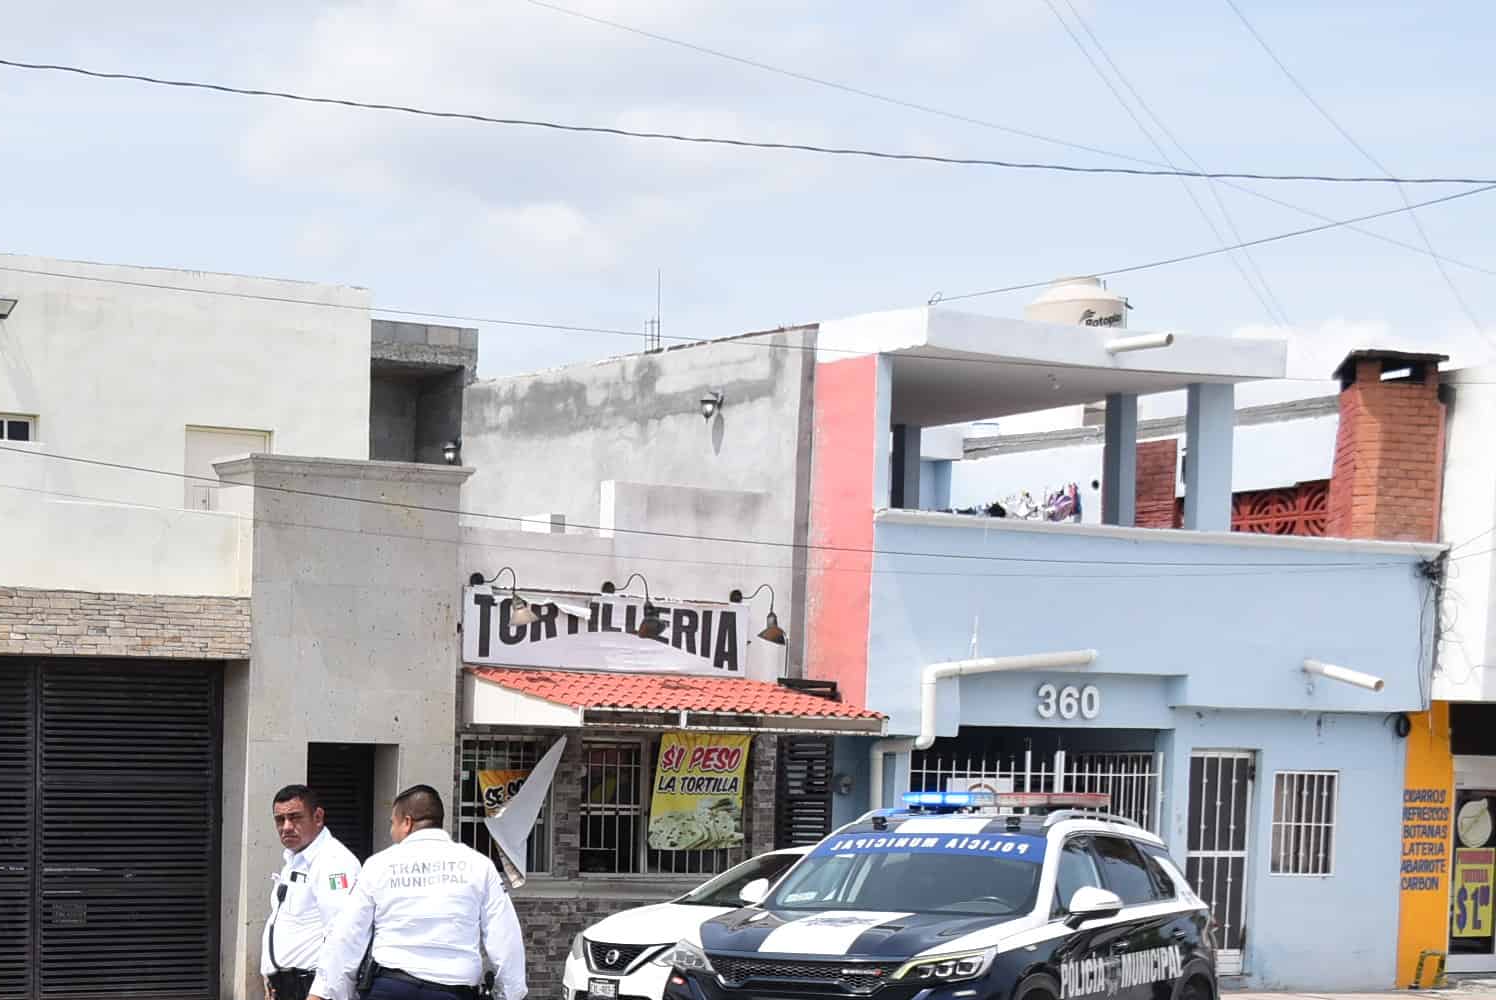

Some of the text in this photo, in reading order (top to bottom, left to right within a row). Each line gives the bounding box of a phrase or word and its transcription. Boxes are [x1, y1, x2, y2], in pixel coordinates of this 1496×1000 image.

[1037, 684, 1100, 719] 360
[688, 746, 743, 772] PESO
[657, 775, 739, 793] LA TORTILLA
[1403, 825, 1447, 839] BOTANAS
[390, 874, 468, 888] MUNICIPAL
[1121, 945, 1184, 988] MUNICIPAL
